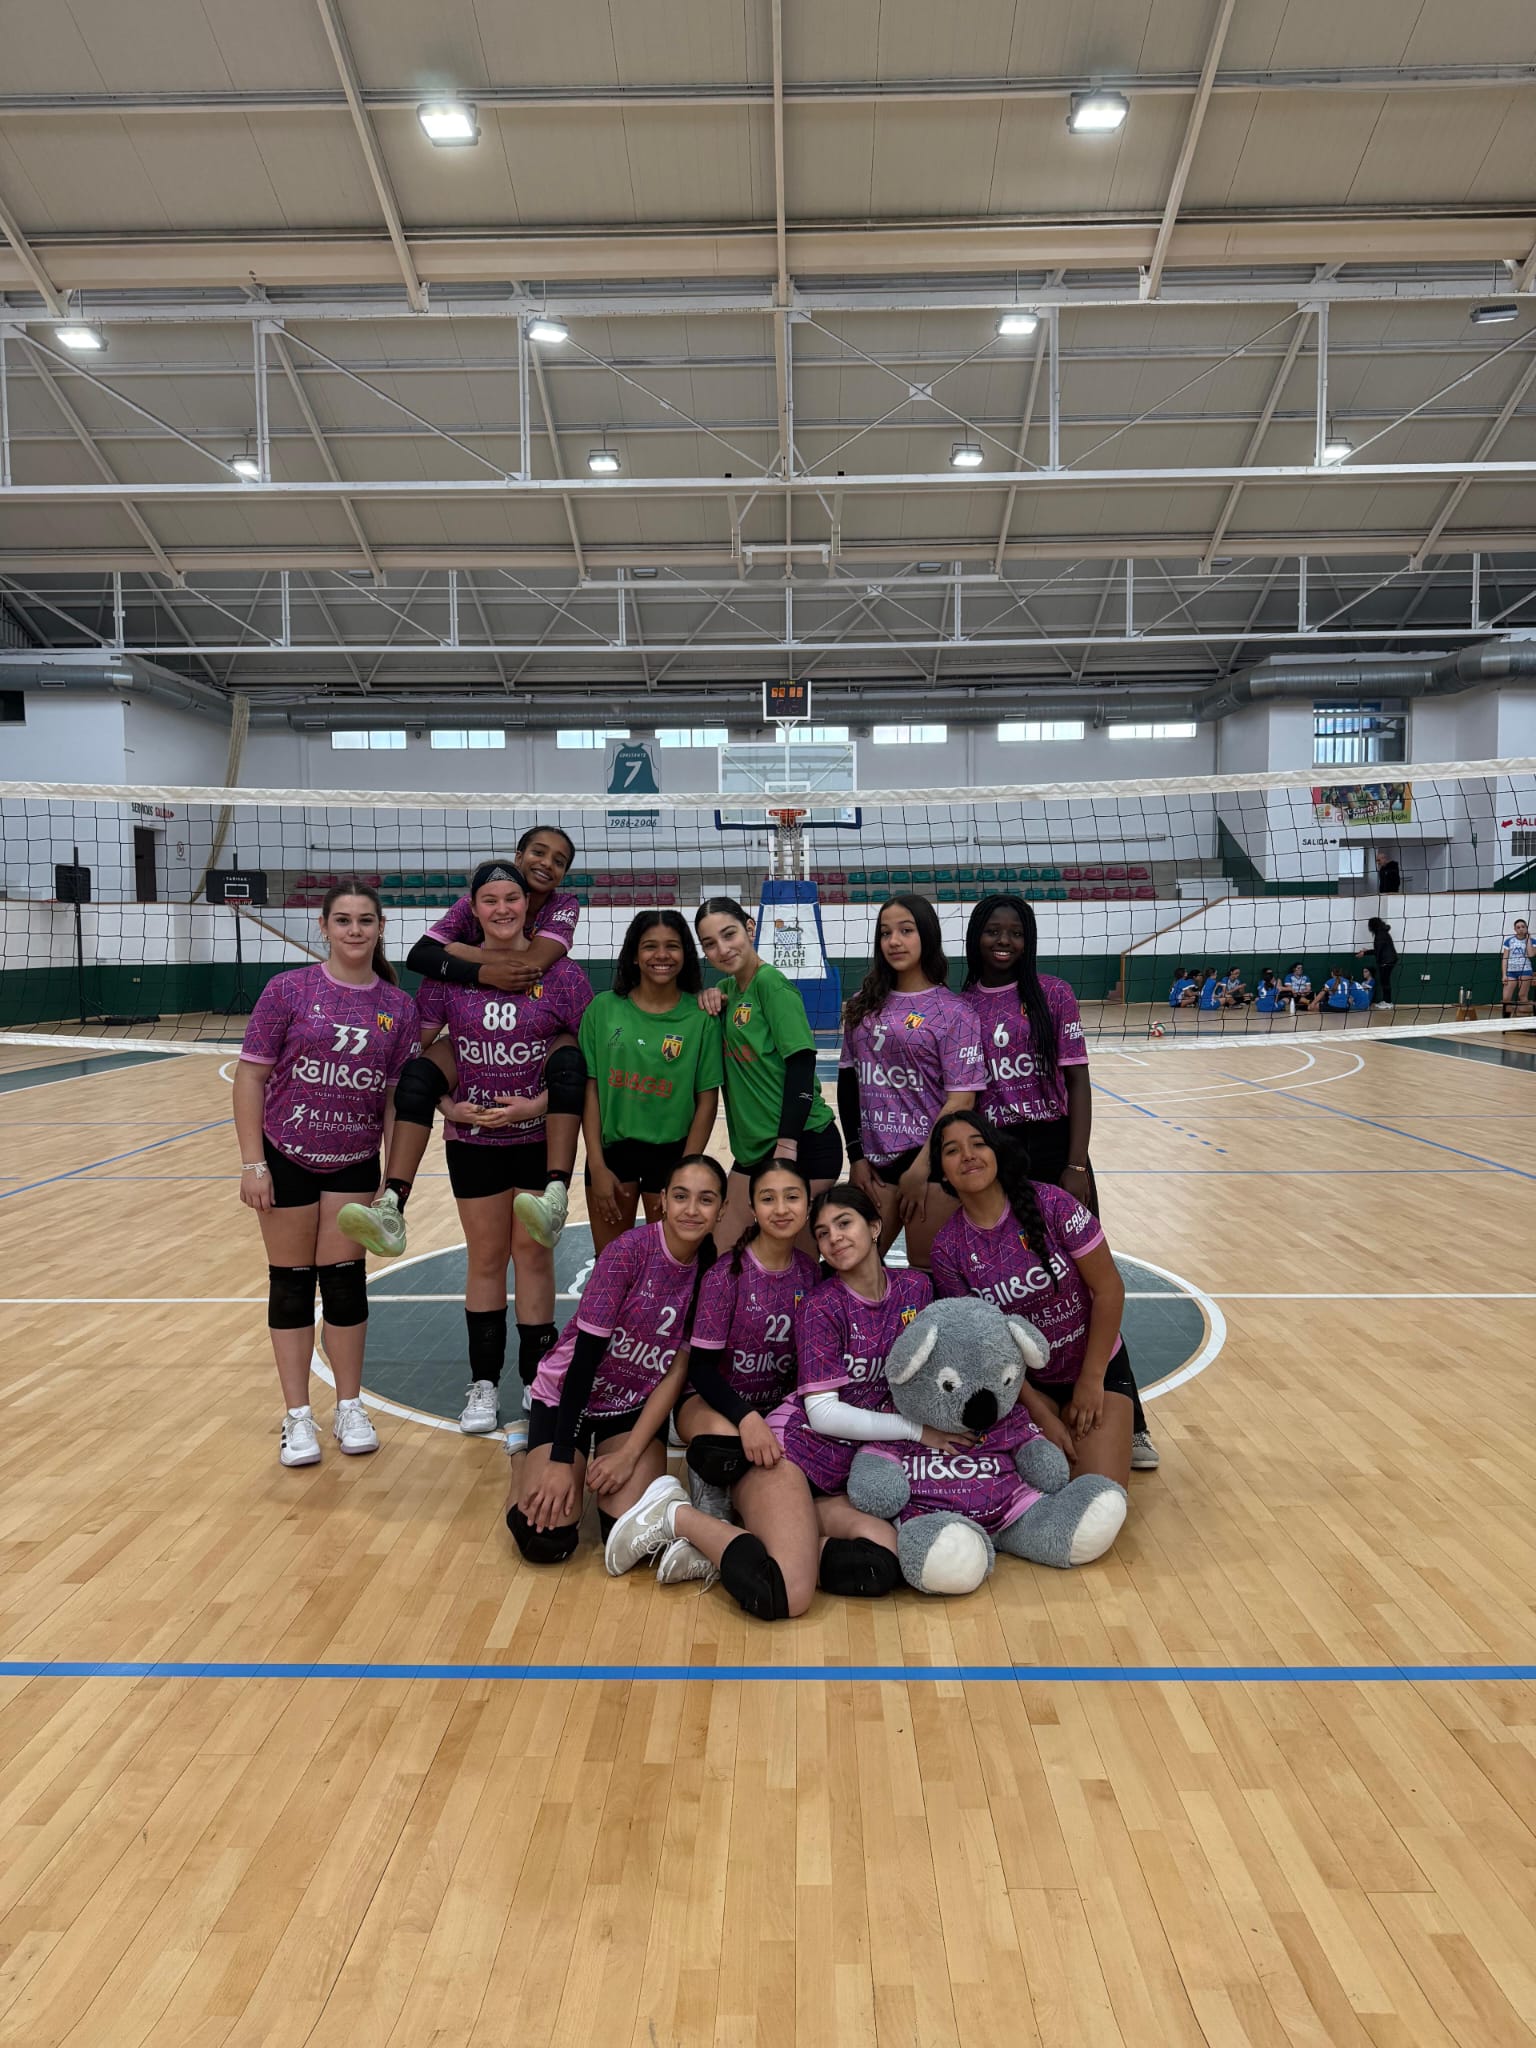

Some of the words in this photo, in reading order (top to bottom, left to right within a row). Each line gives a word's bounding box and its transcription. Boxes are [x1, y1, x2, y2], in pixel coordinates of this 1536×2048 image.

[625, 761, 642, 788] 7
[1302, 838, 1328, 846] SALIDA
[774, 958, 805, 967] CALPE
[483, 1001, 517, 1031] 88
[1065, 1022, 1081, 1034] CAL
[331, 1023, 370, 1055] 33
[873, 1024, 888, 1051] 5
[994, 1023, 1010, 1048] 6
[959, 1044, 983, 1059] CAL
[860, 1109, 929, 1126] KINETIC
[656, 1306, 677, 1336] 2
[764, 1314, 791, 1342] 22
